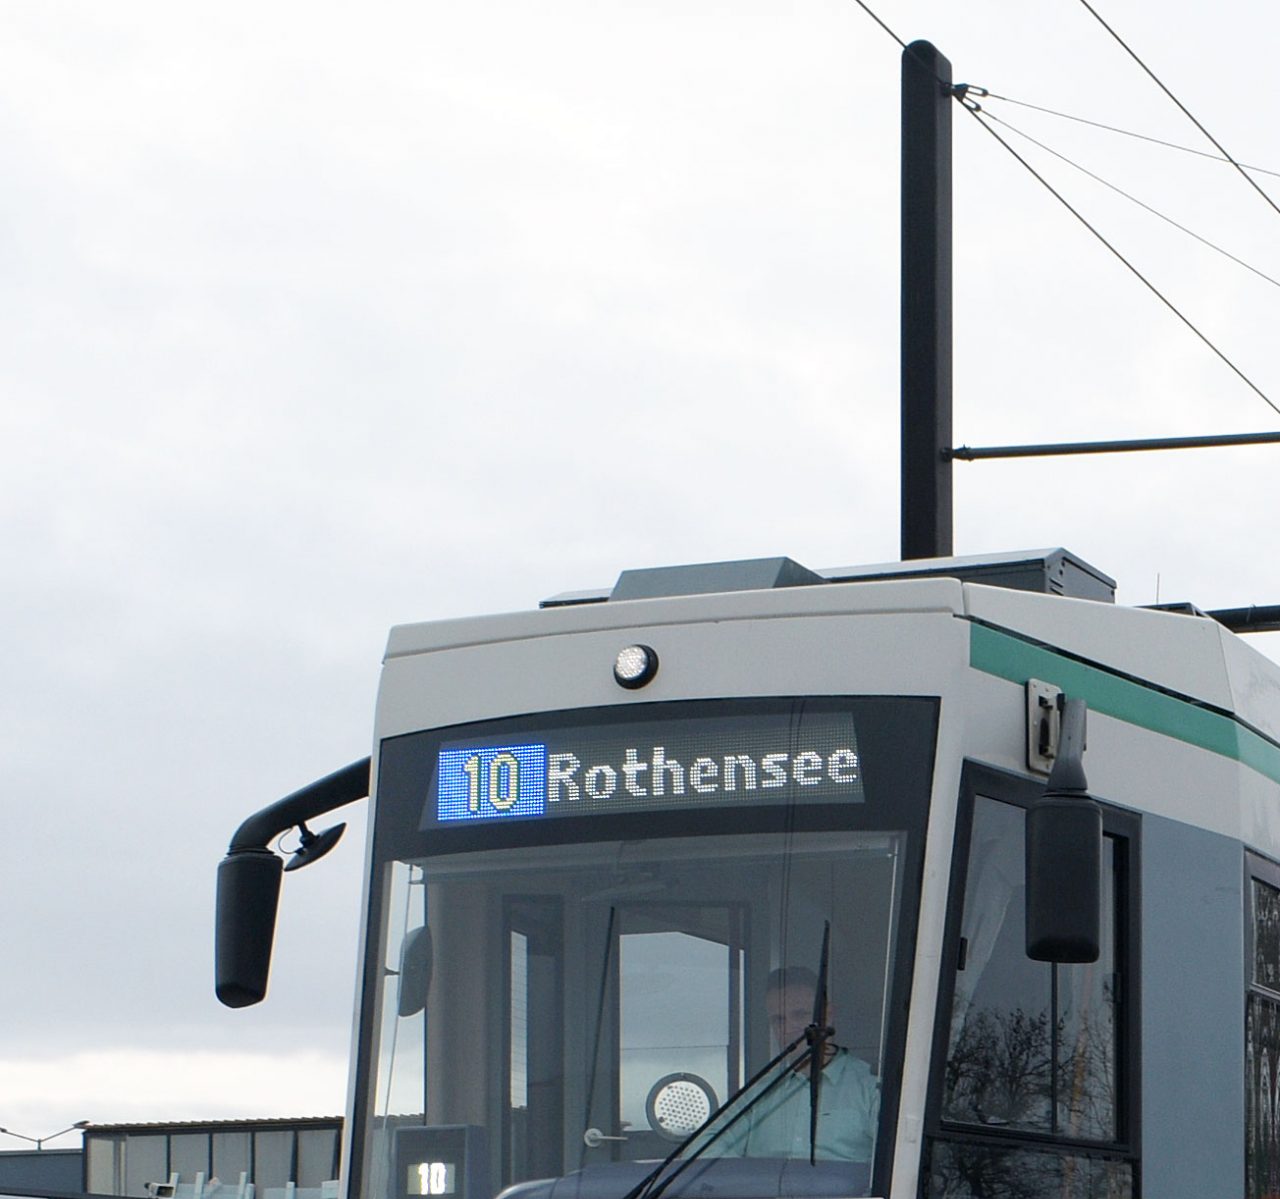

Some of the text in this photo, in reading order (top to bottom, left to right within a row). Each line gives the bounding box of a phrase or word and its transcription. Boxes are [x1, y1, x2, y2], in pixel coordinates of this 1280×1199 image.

[463, 747, 859, 813] 10 Rothensee
[417, 1161, 447, 1195] 10
